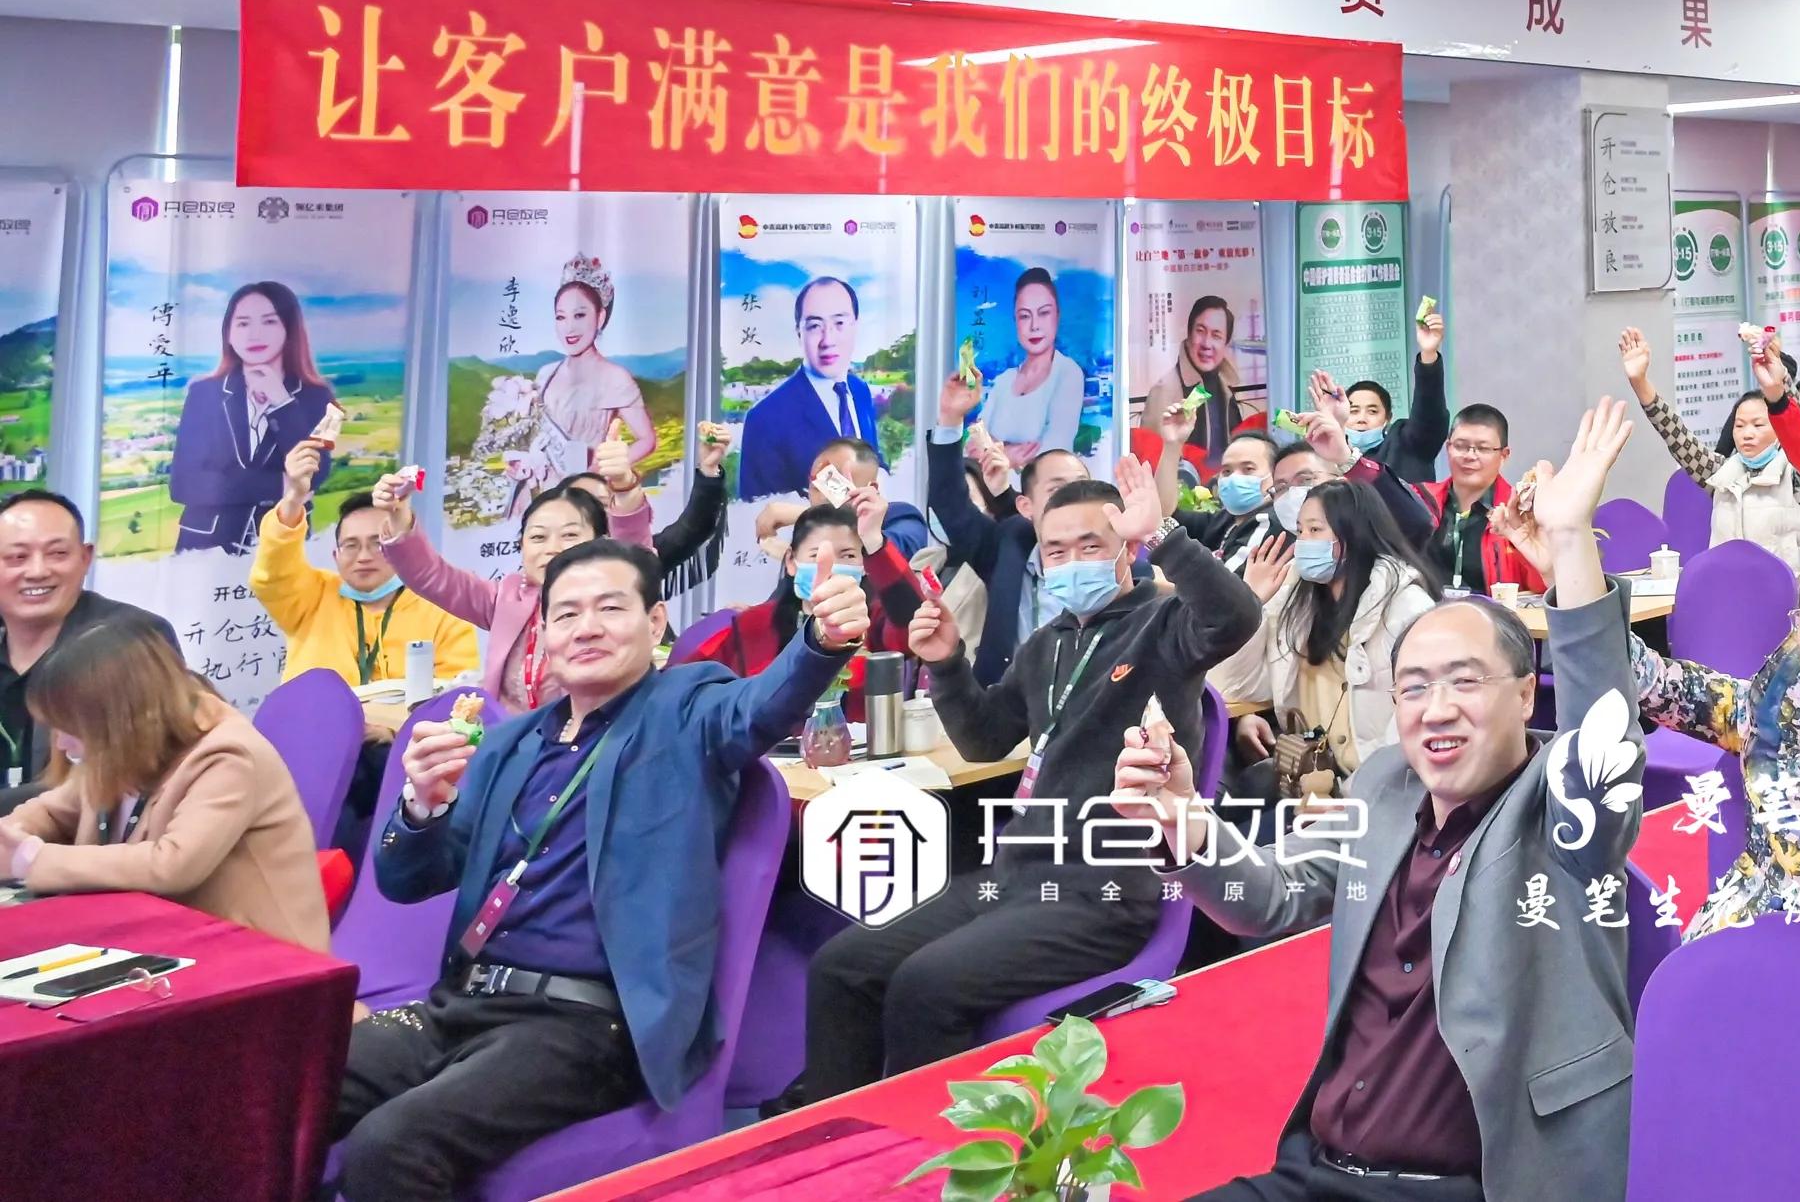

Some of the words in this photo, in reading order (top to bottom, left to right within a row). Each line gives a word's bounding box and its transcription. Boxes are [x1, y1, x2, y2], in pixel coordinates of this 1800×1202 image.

[310, 4, 1376, 167] 让客户满意是我们的终极目标
[214, 585, 257, 602] 开仓
